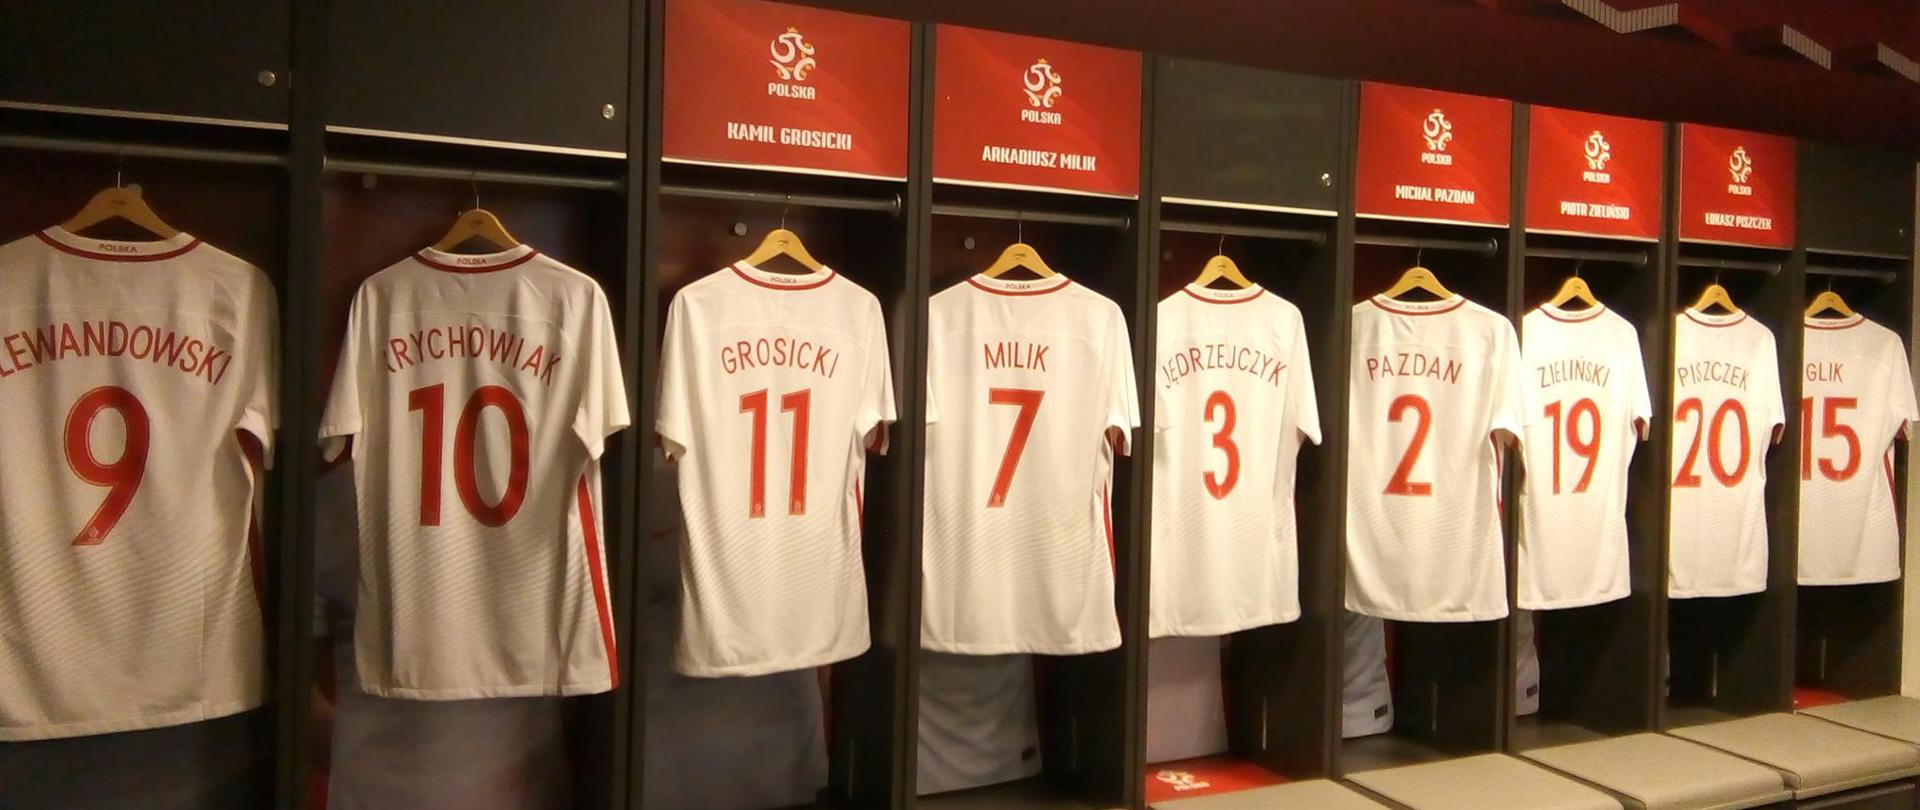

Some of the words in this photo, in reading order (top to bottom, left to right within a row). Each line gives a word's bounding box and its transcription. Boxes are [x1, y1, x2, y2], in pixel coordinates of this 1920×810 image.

[768, 82, 816, 100] POLSKA
[1021, 109, 1061, 125] POLSKA
[727, 121, 777, 144] KAMIL
[780, 127, 853, 151] GROSICKI
[982, 145, 1058, 168] ARKADIUSZ
[1060, 152, 1096, 172] MILIK
[1421, 152, 1453, 166] POLSKA
[1434, 187, 1475, 205] PAZDAN
[1560, 201, 1588, 217] PIOTR
[1735, 215, 1772, 231] PISZCZEK
[99, 243, 138, 254] POLSKA
[721, 337, 839, 379] GROSICKI
[983, 341, 1050, 373] MILIK
[1162, 344, 1287, 389] JĘDRZEJCZYK
[1366, 353, 1462, 385] PAZDAN
[1536, 355, 1611, 388] ZIELIŃSKI
[1806, 362, 1844, 383] GLIK
[1677, 361, 1750, 391] PISZCZEK
[739, 387, 812, 518] 11
[987, 387, 1045, 507] 7
[1203, 390, 1241, 500] 3
[1383, 393, 1433, 497] 2
[1544, 397, 1601, 496] 19
[1673, 397, 1751, 488] 20
[1801, 396, 1862, 482] 15
[63, 385, 149, 546] 9
[408, 384, 529, 527] 10
